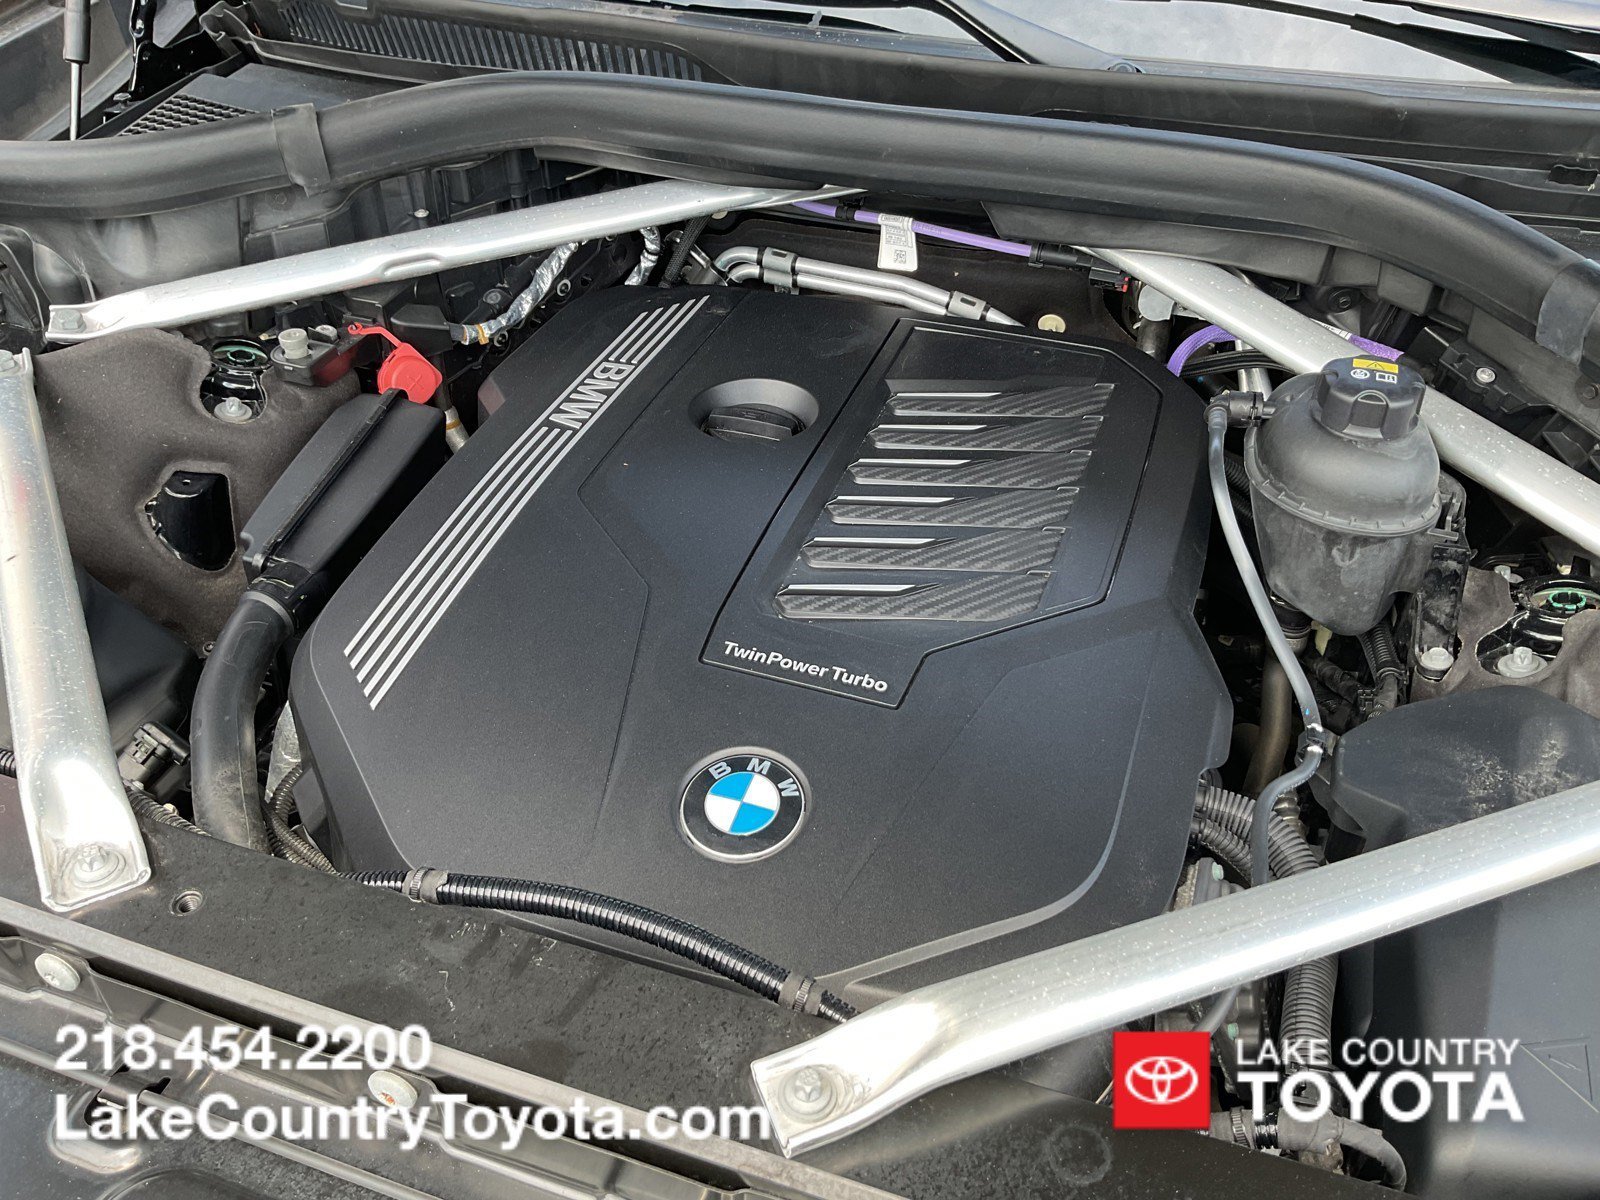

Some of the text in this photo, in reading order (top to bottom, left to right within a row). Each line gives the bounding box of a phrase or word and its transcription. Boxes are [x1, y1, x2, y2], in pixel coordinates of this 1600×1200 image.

[549, 361, 635, 430] BMW
[724, 641, 889, 692] TwinPower Turbo
[708, 757, 800, 797] BMW
